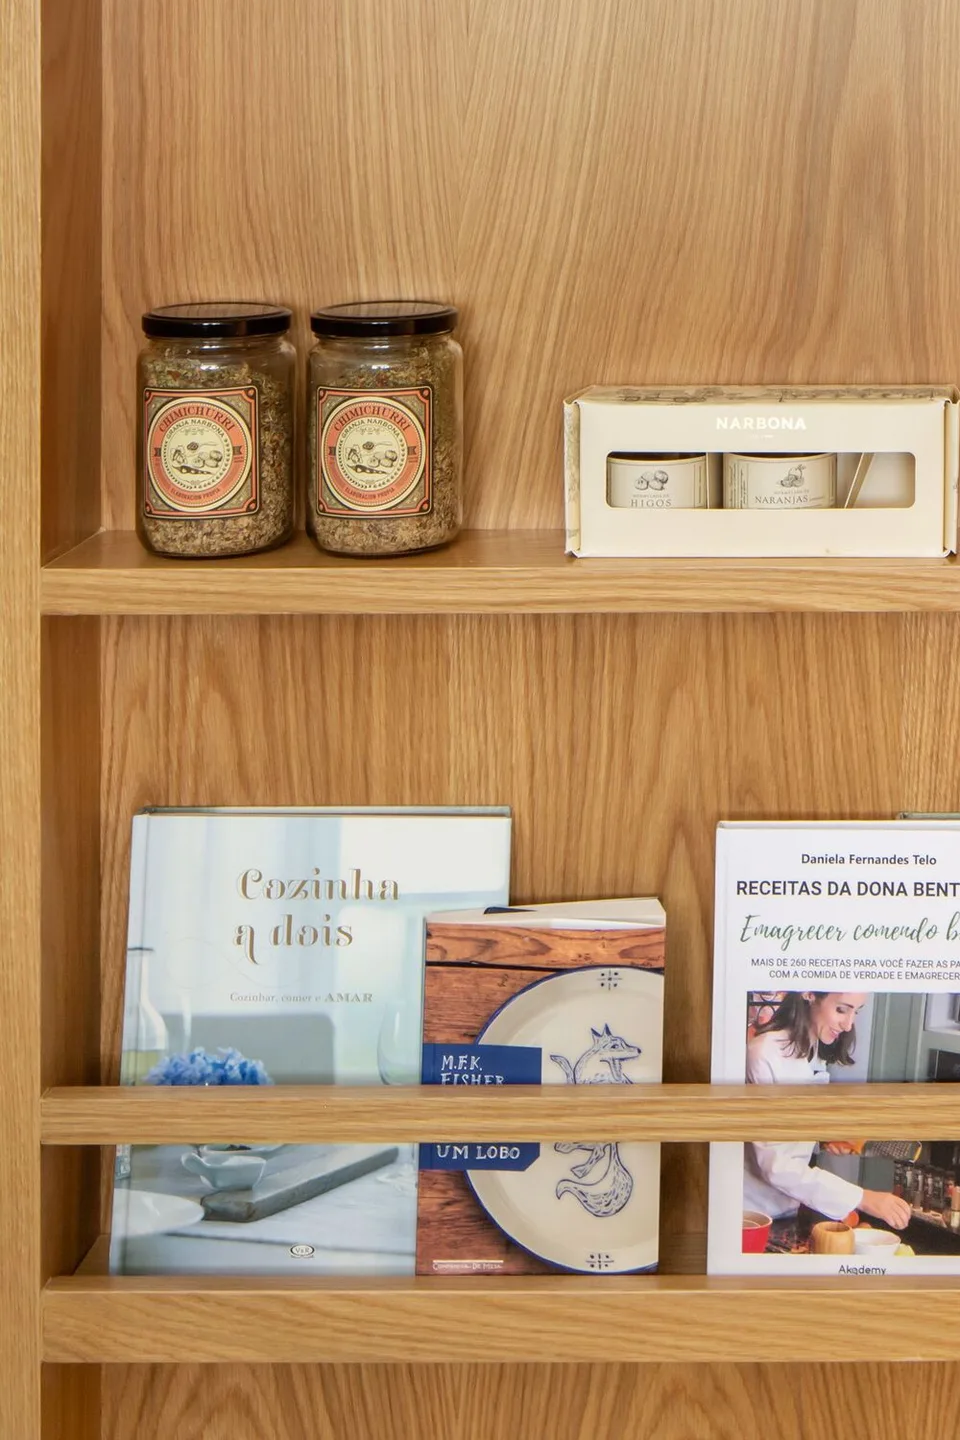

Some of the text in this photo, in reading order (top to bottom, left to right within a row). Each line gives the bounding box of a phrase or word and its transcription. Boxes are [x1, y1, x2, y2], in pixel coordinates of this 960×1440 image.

[158, 405, 236, 433] CHIMICHURRI
[333, 404, 412, 432] CHIMICHURRI
[716, 416, 807, 430] NARBONA
[341, 418, 401, 439] GRANJA NARBONA
[631, 498, 672, 508] HIGOS
[755, 495, 809, 505] NARANJAS
[801, 853, 938, 866] Daniela Fernandes Telo
[236, 867, 400, 902] Cozinha
[735, 880, 822, 896] RECEITAS
[827, 881, 852, 897] DA
[857, 881, 908, 897] DONA
[270, 913, 354, 948] dois
[740, 914, 847, 952] Emagrecer
[853, 917, 940, 944] comendo
[751, 958, 774, 968] MAIS
[776, 958, 788, 968] DE
[790, 958, 806, 968] 260
[808, 959, 851, 969] RECEITAS
[853, 960, 877, 969] PARA
[879, 958, 904, 970] VOCÊ
[906, 960, 934, 970] FAZER
[936, 961, 948, 970] AS
[769, 970, 960, 981] COM A COMIDA DE VERDADE E EMAGRECER
[281, 993, 312, 1003] comer
[324, 993, 374, 1003] AMAR
[441, 1054, 483, 1071] M.F.K.
[437, 1144, 521, 1160] UM LOBO
[838, 1264, 887, 1276] Akademy
